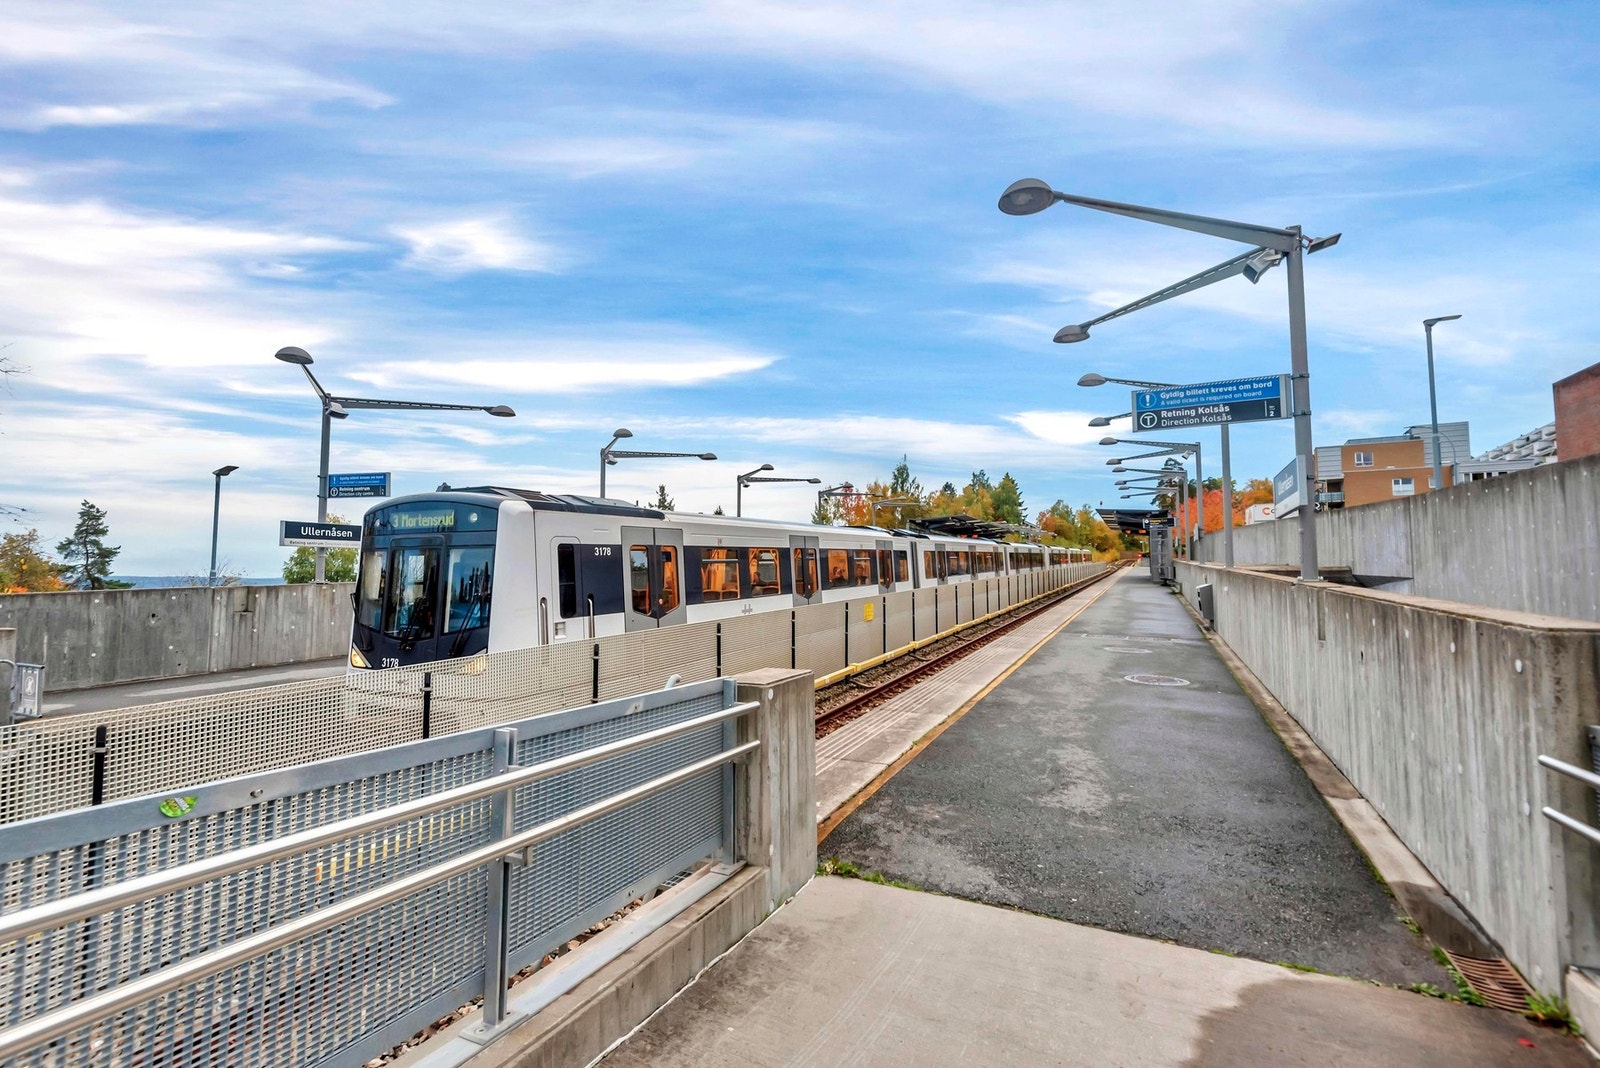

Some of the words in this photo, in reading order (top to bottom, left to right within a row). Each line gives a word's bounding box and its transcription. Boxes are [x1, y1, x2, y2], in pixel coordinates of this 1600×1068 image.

[1160, 391, 1185, 400] Gyldig
[1186, 388, 1209, 396] billett
[1211, 385, 1237, 393] kreves
[1253, 381, 1273, 389] bord
[1161, 408, 1196, 418] Retning
[1198, 403, 1231, 415] Kolsås
[1161, 416, 1200, 427] Direction
[1201, 413, 1233, 423] Kolsås
[301, 526, 353, 538] Ullernåsen
[594, 546, 612, 556] 3178
[381, 657, 400, 668] 3178
